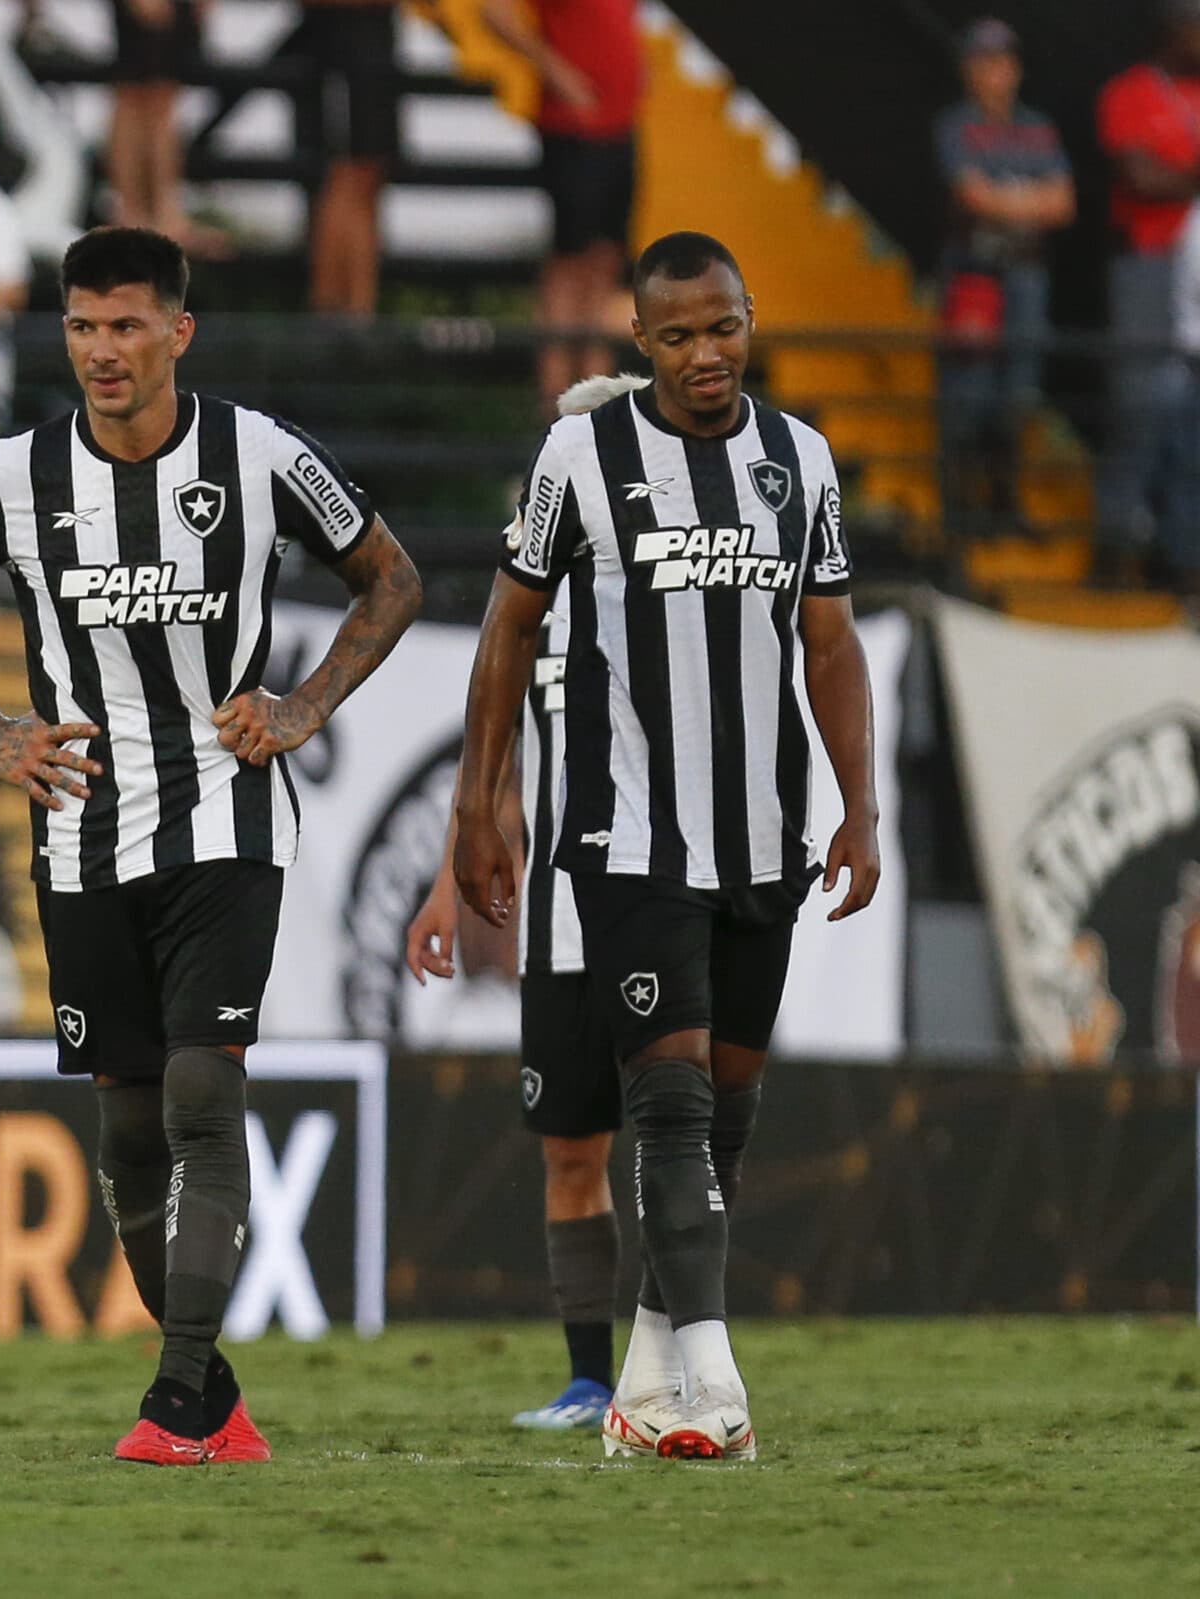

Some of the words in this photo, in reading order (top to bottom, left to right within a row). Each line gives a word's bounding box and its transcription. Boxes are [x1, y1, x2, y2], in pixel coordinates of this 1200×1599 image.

[294, 452, 355, 530] Centrum
[524, 475, 554, 569] Centrum
[634, 527, 751, 562] PARI
[60, 564, 174, 598] PARI
[651, 557, 797, 589] MATCH
[78, 591, 228, 625] MATCH
